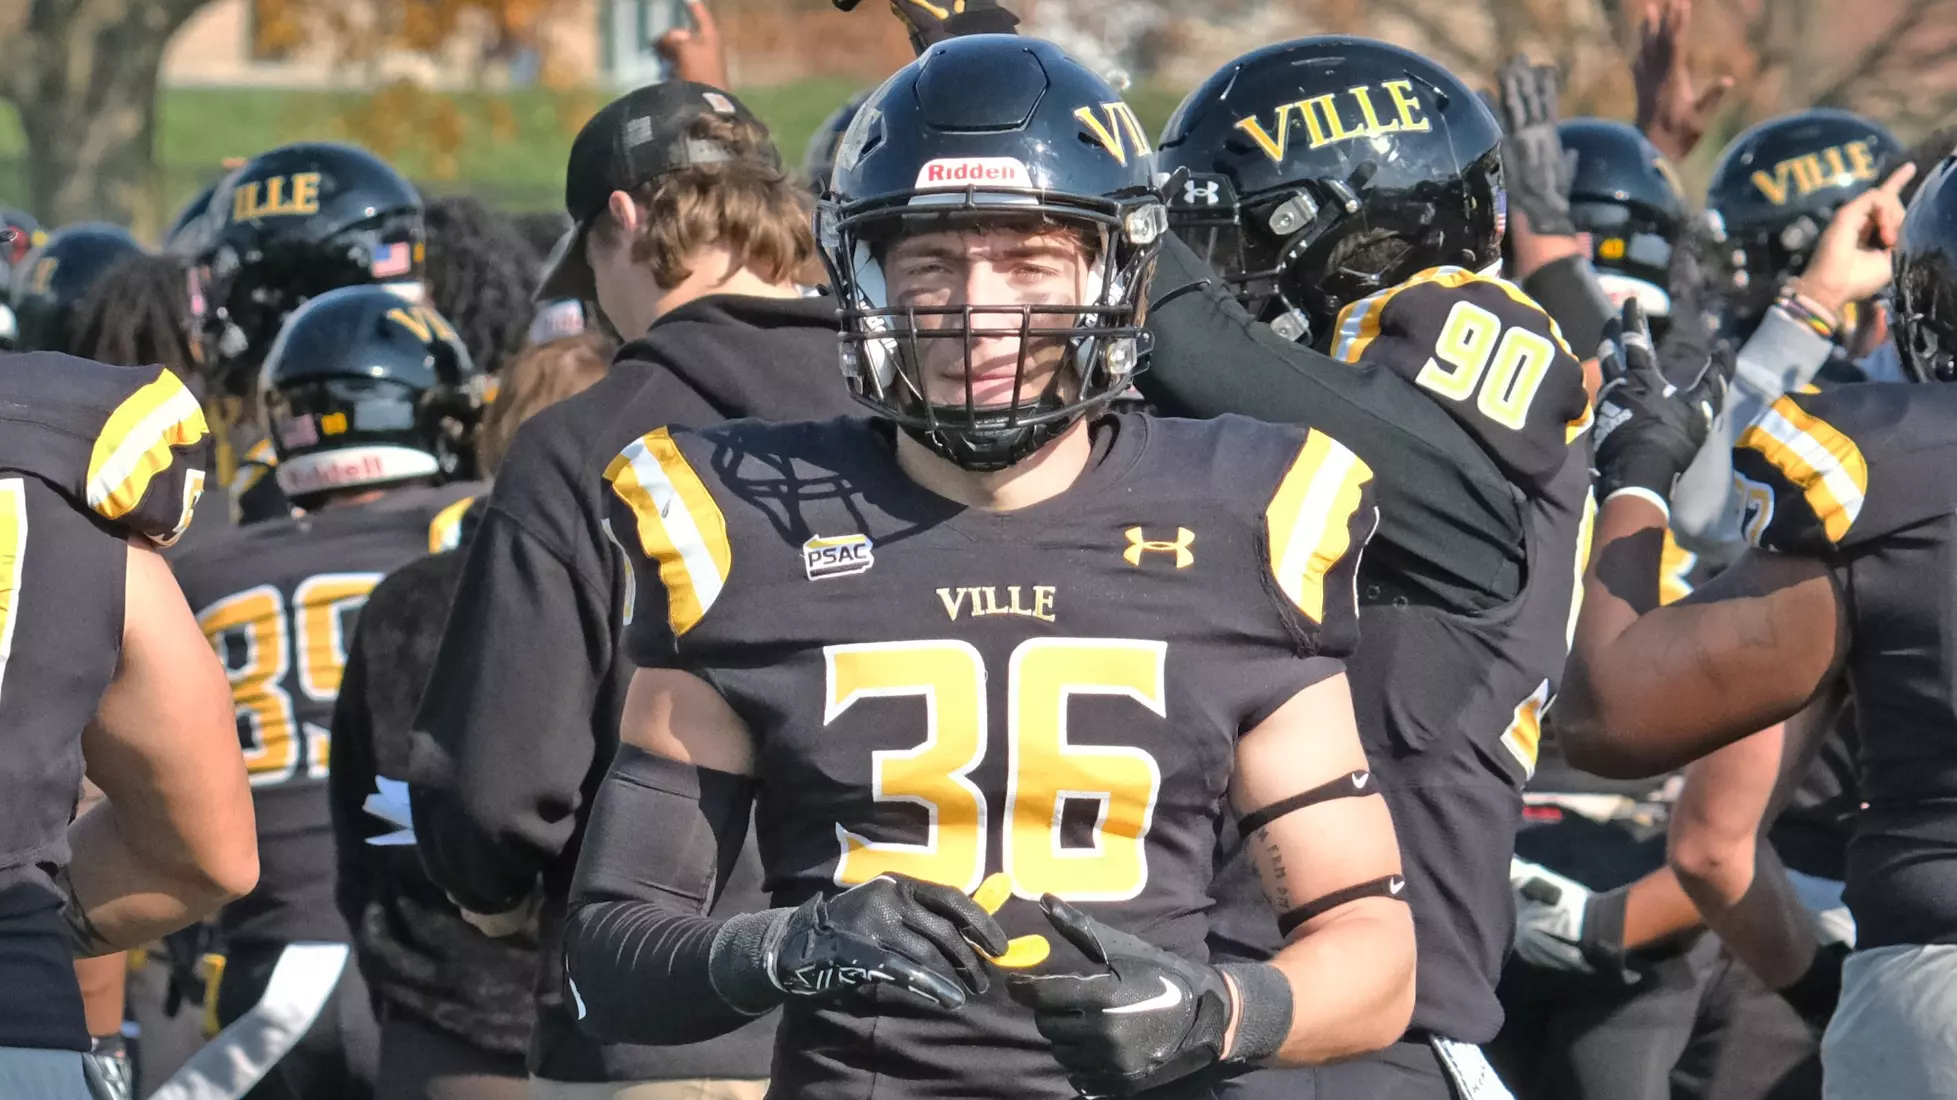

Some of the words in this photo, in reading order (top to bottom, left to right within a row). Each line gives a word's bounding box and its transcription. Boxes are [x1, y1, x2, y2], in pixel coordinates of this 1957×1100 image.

[1234, 80, 1431, 162] VILLE
[928, 163, 1015, 181] Riddell
[1752, 141, 1877, 205] VILLE
[1415, 301, 1555, 430] 90
[808, 543, 867, 567] PSAC
[936, 586, 1056, 621] VILLE
[823, 637, 1167, 902] 36
